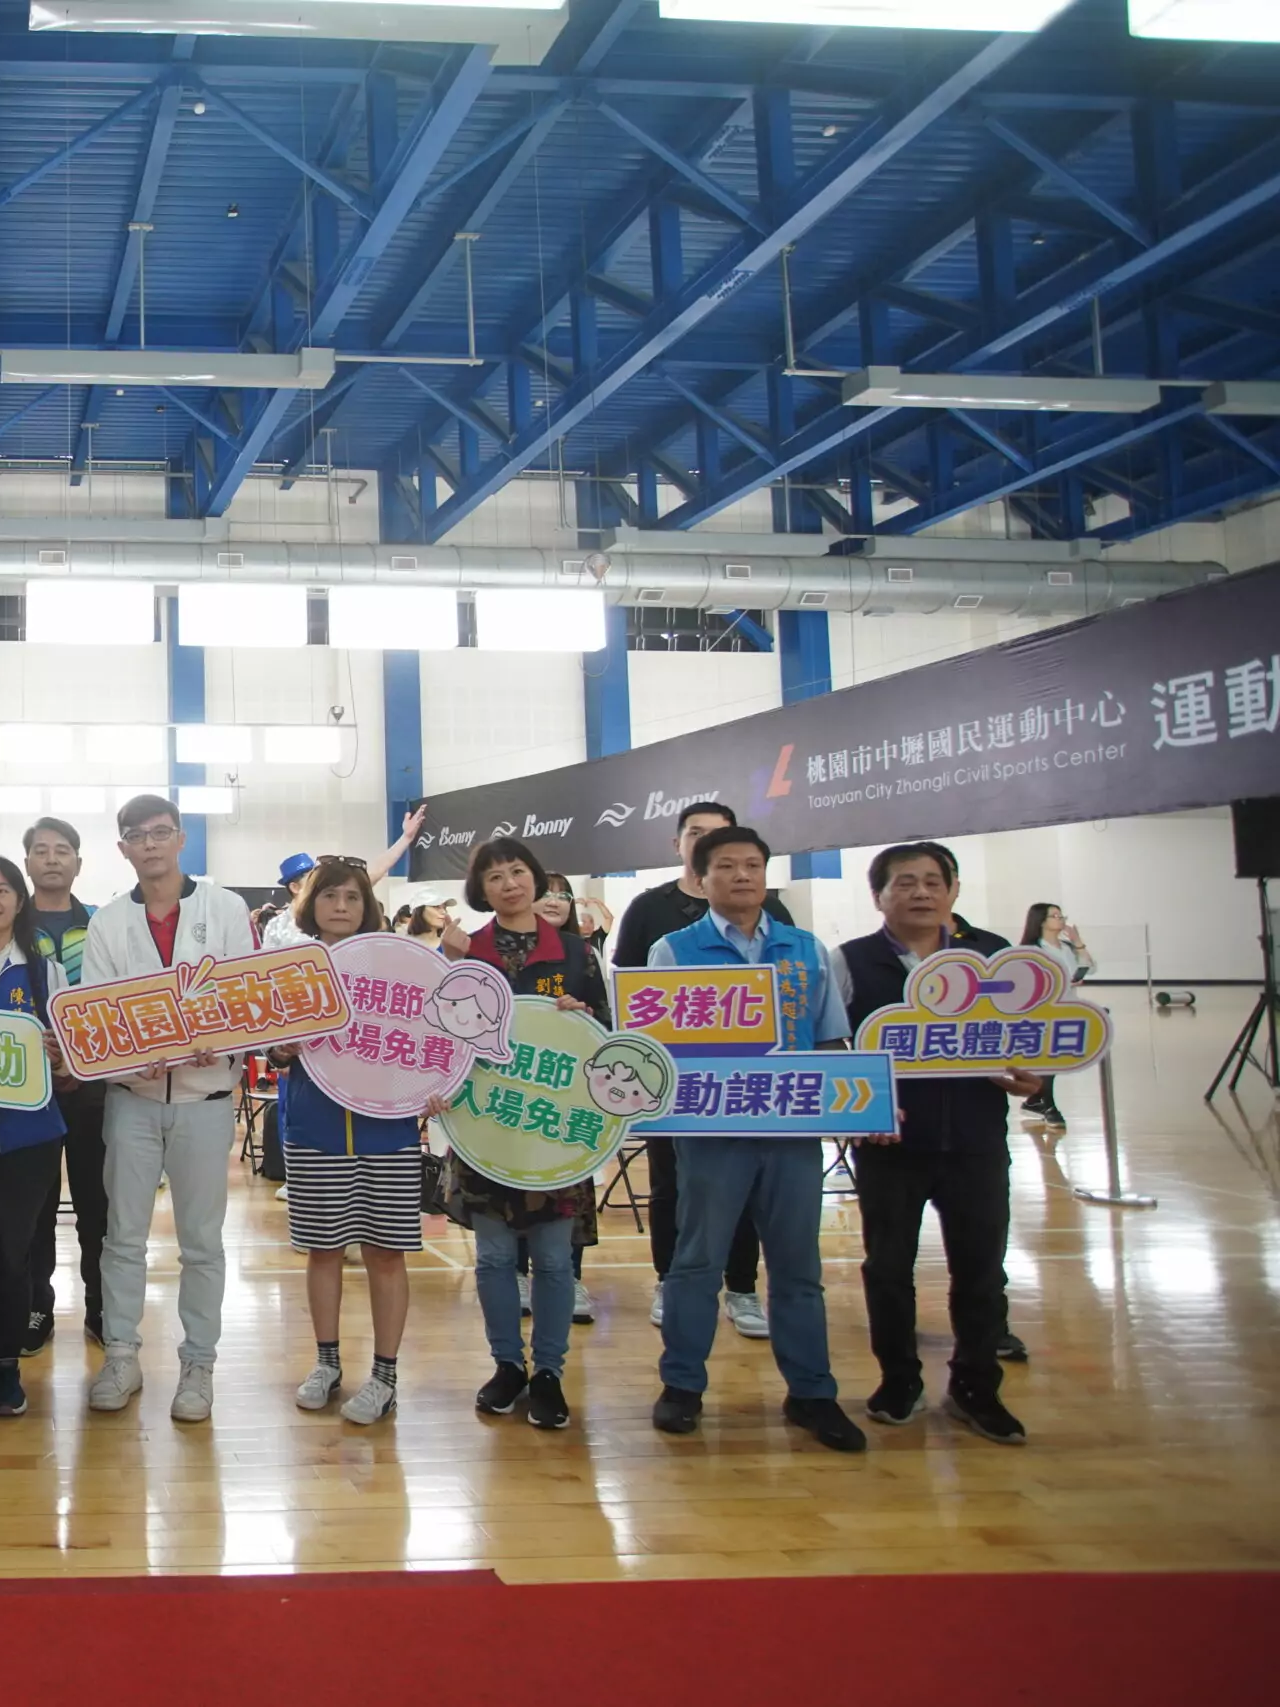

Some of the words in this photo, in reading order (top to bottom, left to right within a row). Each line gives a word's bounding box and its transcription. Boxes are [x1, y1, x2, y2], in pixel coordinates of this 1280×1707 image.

[1150, 653, 1280, 751] 運動
[805, 689, 1127, 787] 桃園市中壢國民運動中心
[808, 790, 862, 809] Taoyuan
[865, 783, 892, 800] City
[895, 771, 951, 795] Zhongli
[953, 764, 990, 785] Civil
[993, 756, 1050, 781] Sports
[1053, 743, 1127, 769] Center
[438, 826, 476, 847] Bonny
[521, 813, 573, 837] Bonny
[62, 961, 342, 1064] 桃園超敢動
[341, 971, 426, 1020] 親節
[624, 985, 764, 1030] 多樣化
[308, 1020, 456, 1075] 入場免費
[475, 1039, 578, 1090] 親節
[879, 1019, 1087, 1060] 國民體育日
[450, 1078, 605, 1152] 入場免費
